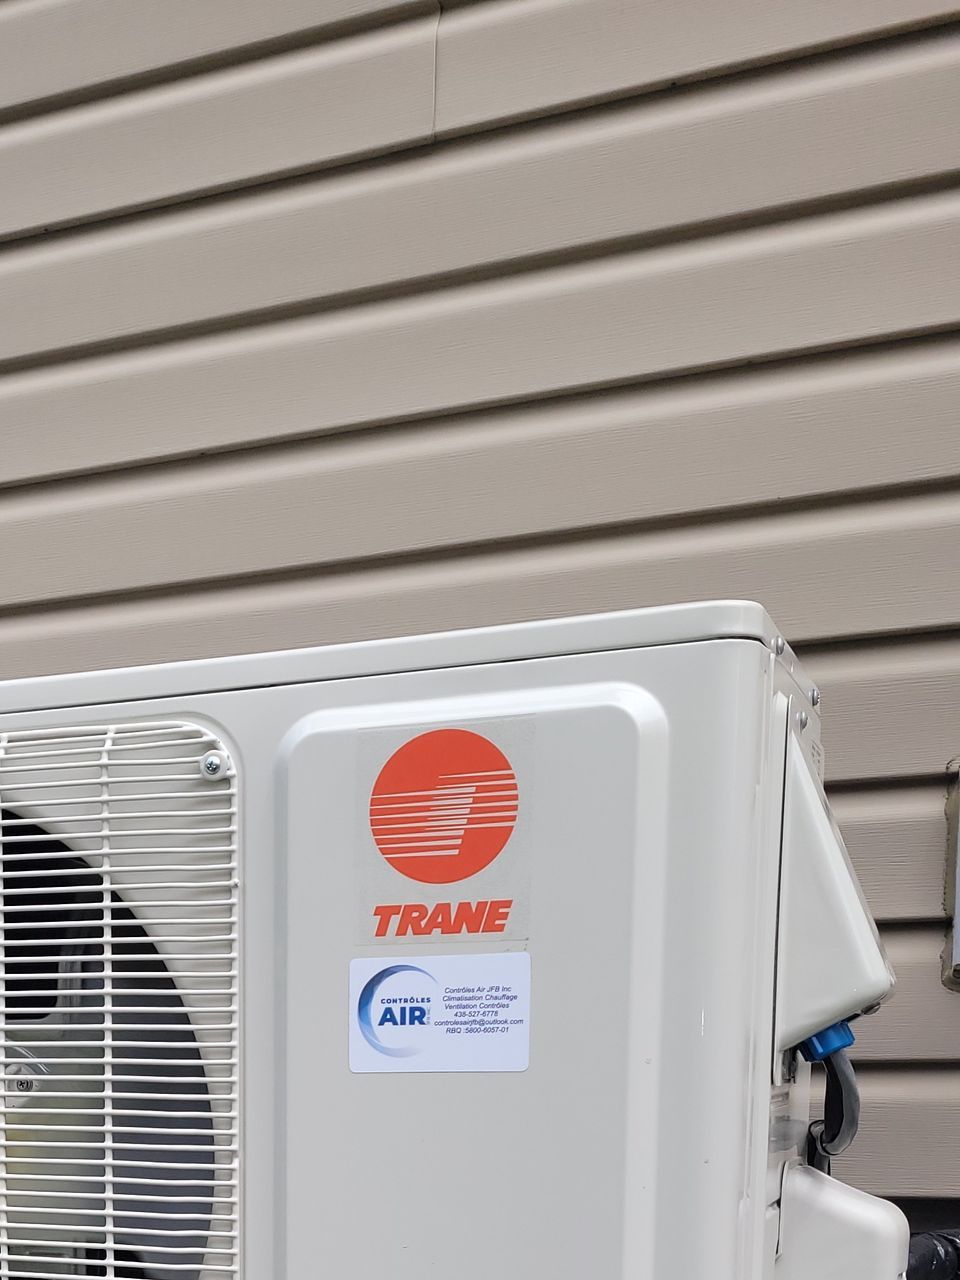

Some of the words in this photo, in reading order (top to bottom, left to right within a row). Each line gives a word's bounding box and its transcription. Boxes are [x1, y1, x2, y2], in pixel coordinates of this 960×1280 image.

[374, 900, 513, 936] TRANE
[381, 996, 431, 1004] CONTRÔLES
[378, 1007, 426, 1026] AIR
